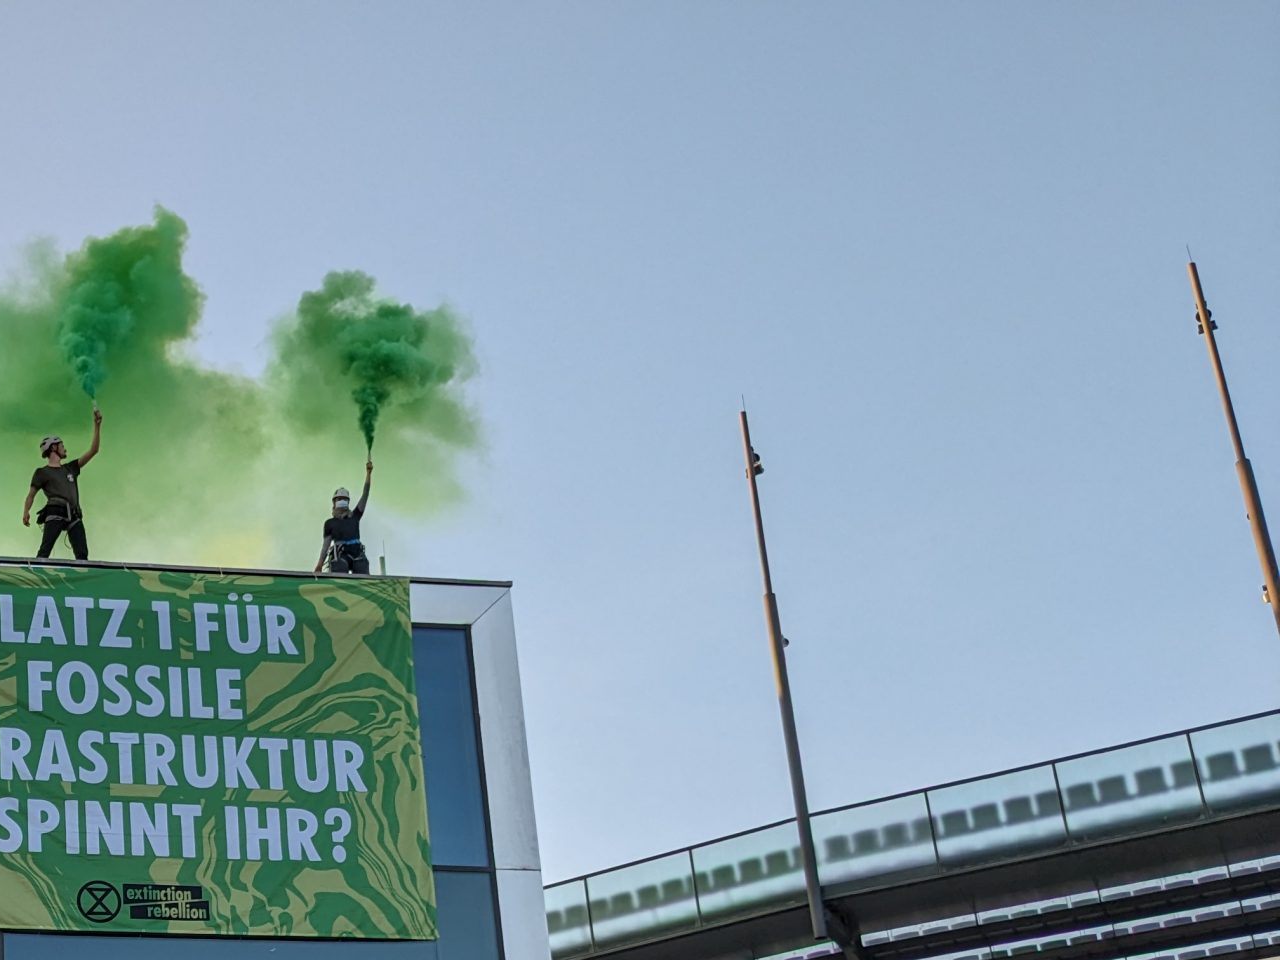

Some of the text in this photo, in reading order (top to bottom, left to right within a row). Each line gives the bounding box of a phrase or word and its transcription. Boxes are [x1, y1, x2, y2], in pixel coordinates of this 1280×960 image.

[152, 601, 173, 650] 1
[194, 593, 299, 655] FÜR
[27, 660, 243, 720] FOSSILE
[224, 805, 352, 863] IHR?
[126, 885, 192, 901] extinction
[147, 901, 207, 919] rebellion
